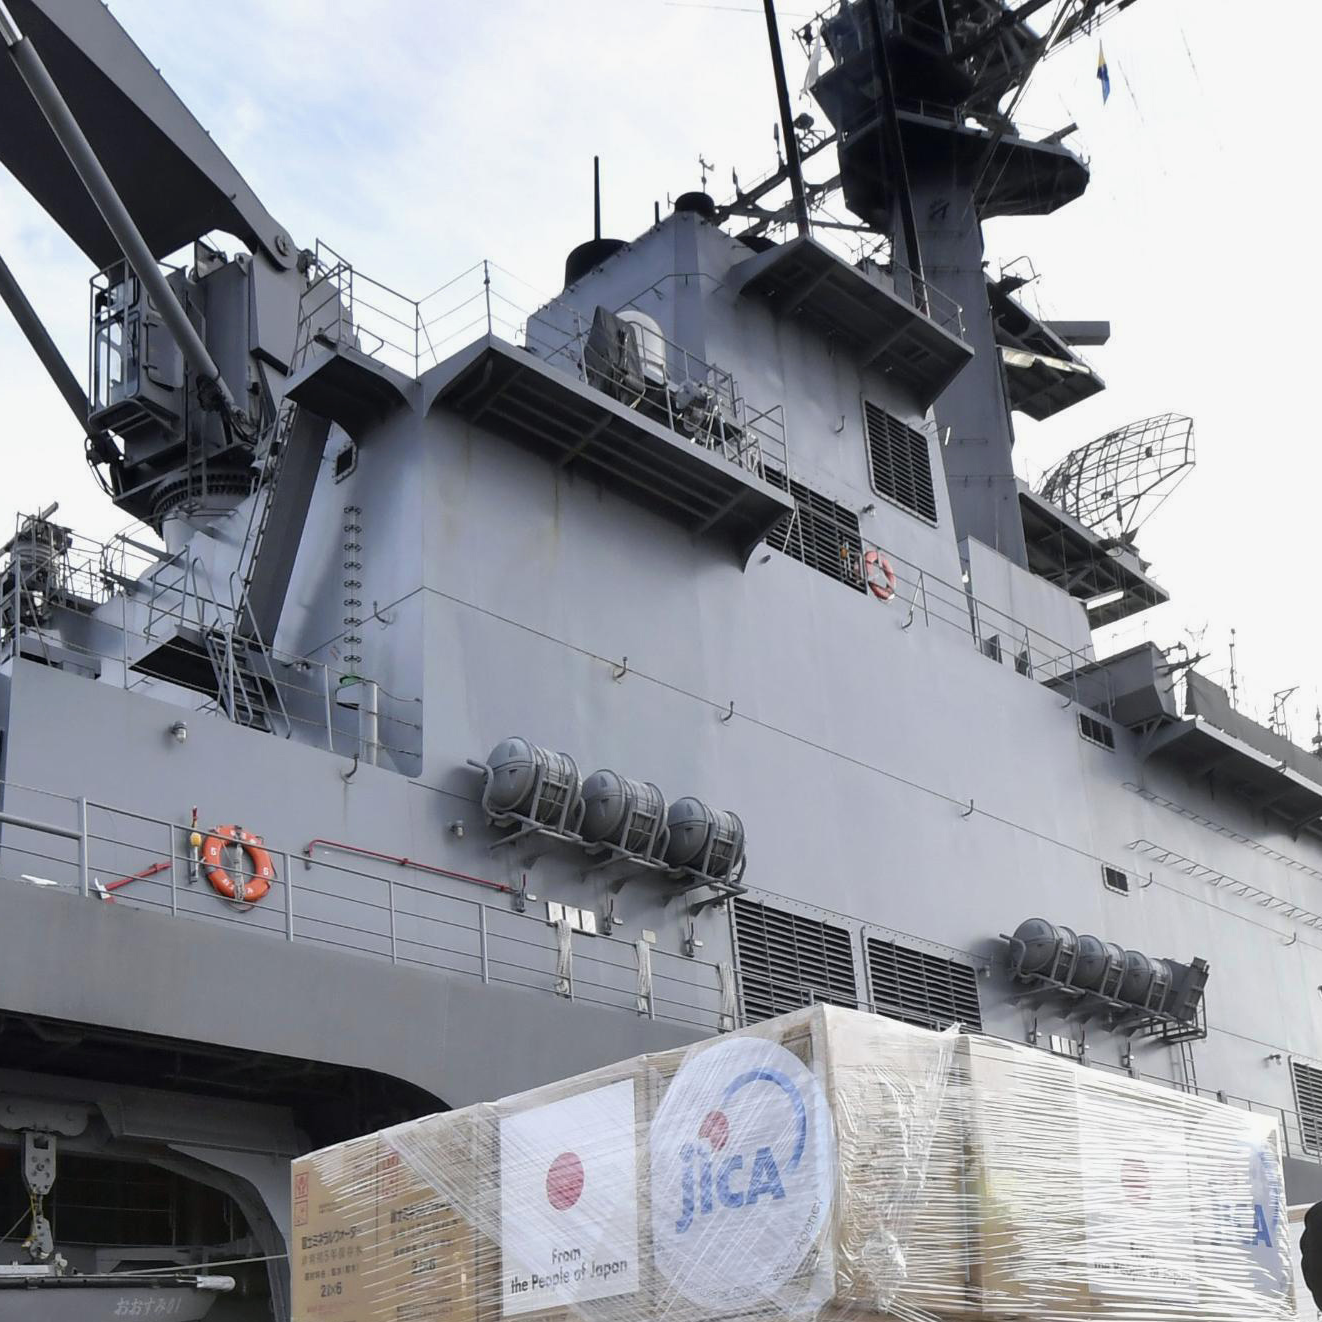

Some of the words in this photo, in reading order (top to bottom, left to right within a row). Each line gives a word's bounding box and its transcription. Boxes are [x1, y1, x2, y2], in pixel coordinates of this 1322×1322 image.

[552, 1248, 581, 1265] From
[511, 1276, 528, 1294] the
[531, 1266, 570, 1292] People
[573, 1261, 587, 1282] of
[589, 1258, 628, 1282] Japan
